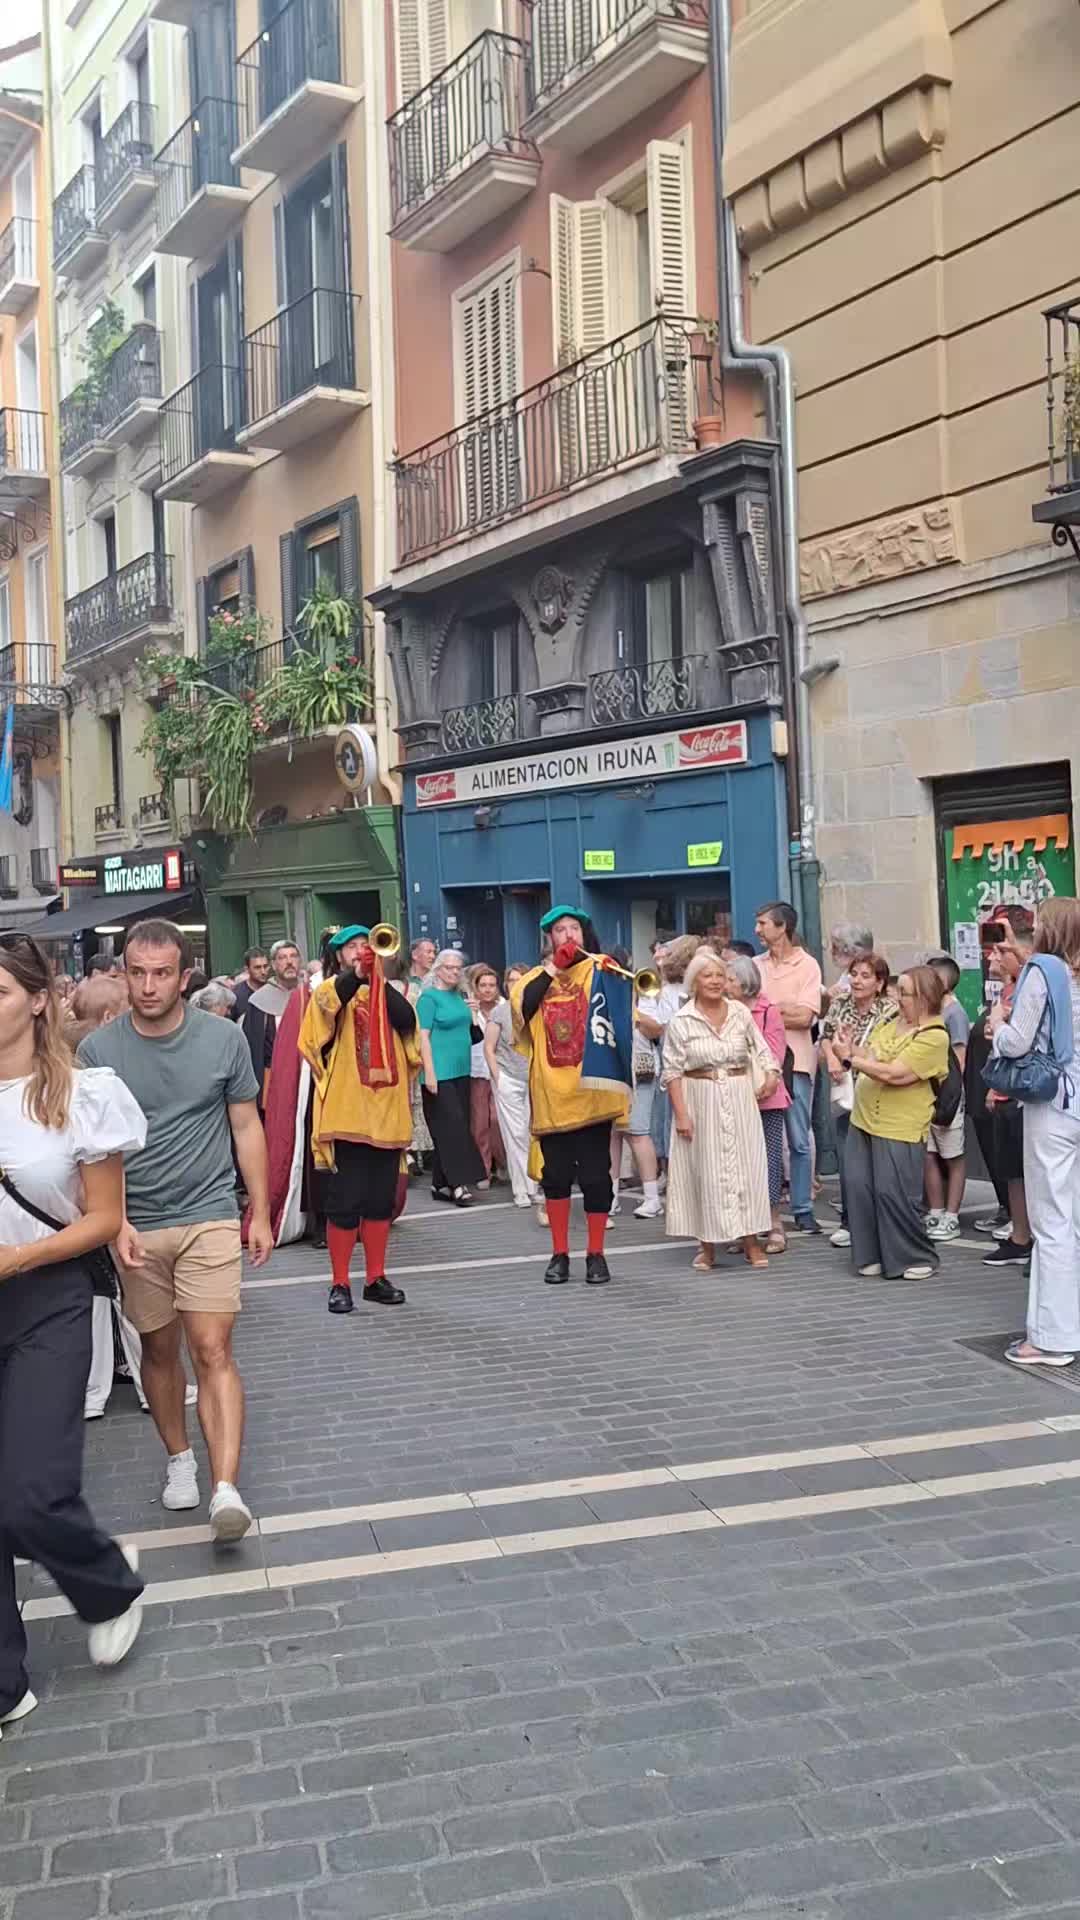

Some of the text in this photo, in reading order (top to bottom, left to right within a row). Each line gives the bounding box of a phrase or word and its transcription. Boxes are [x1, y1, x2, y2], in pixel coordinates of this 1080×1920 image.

[472, 755, 588, 790] ALIMENTACION
[598, 741, 657, 771] IRUÑA
[988, 844, 1019, 872] 9h
[105, 864, 163, 893] MAITAGARRI
